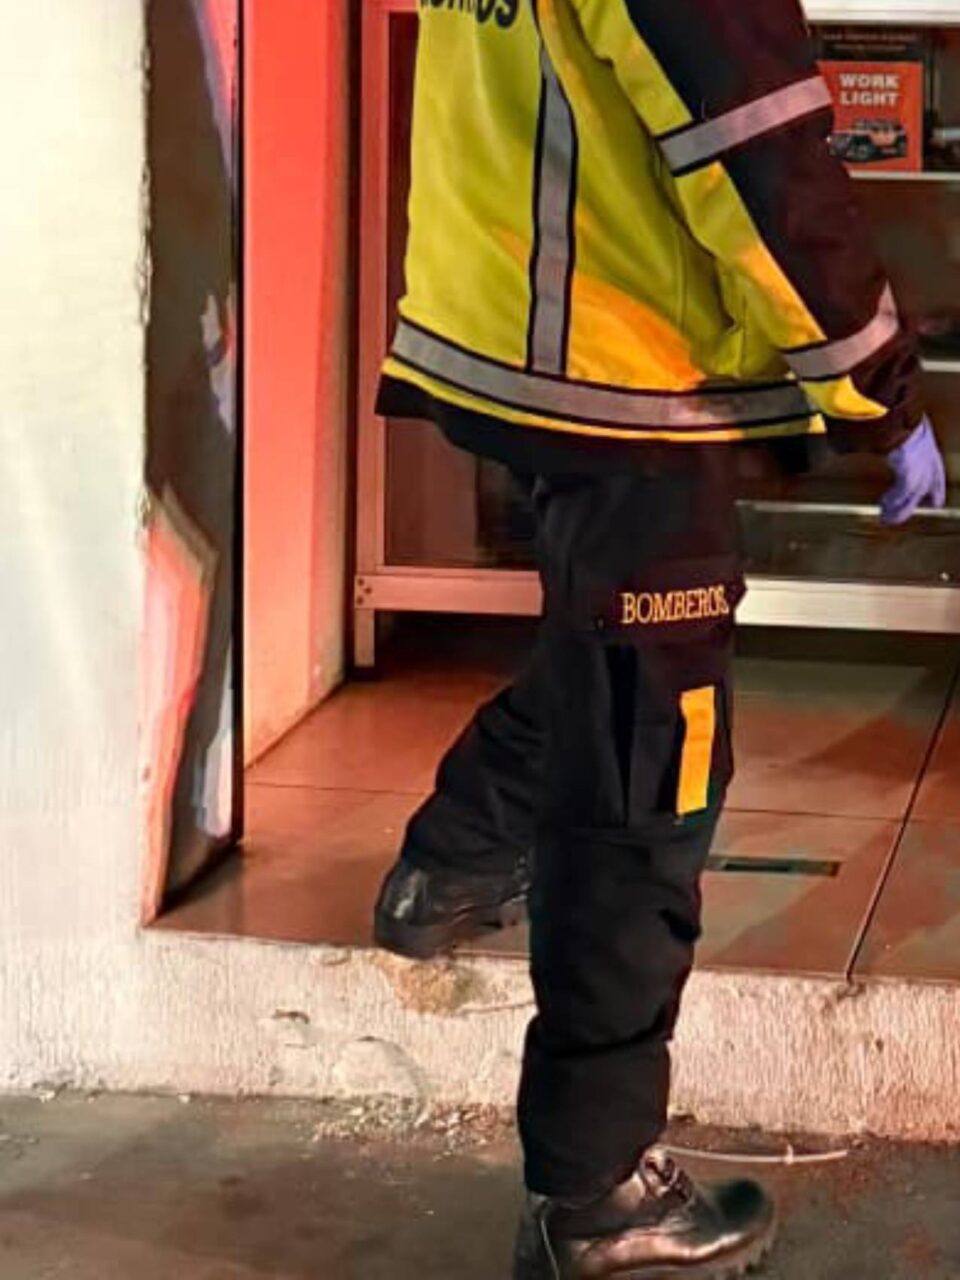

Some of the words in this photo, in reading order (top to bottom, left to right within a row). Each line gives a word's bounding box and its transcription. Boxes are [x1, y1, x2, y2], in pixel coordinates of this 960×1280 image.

[839, 72, 901, 90] WORK
[840, 90, 901, 108] LIGHT
[619, 583, 730, 625] BOMBEROS
